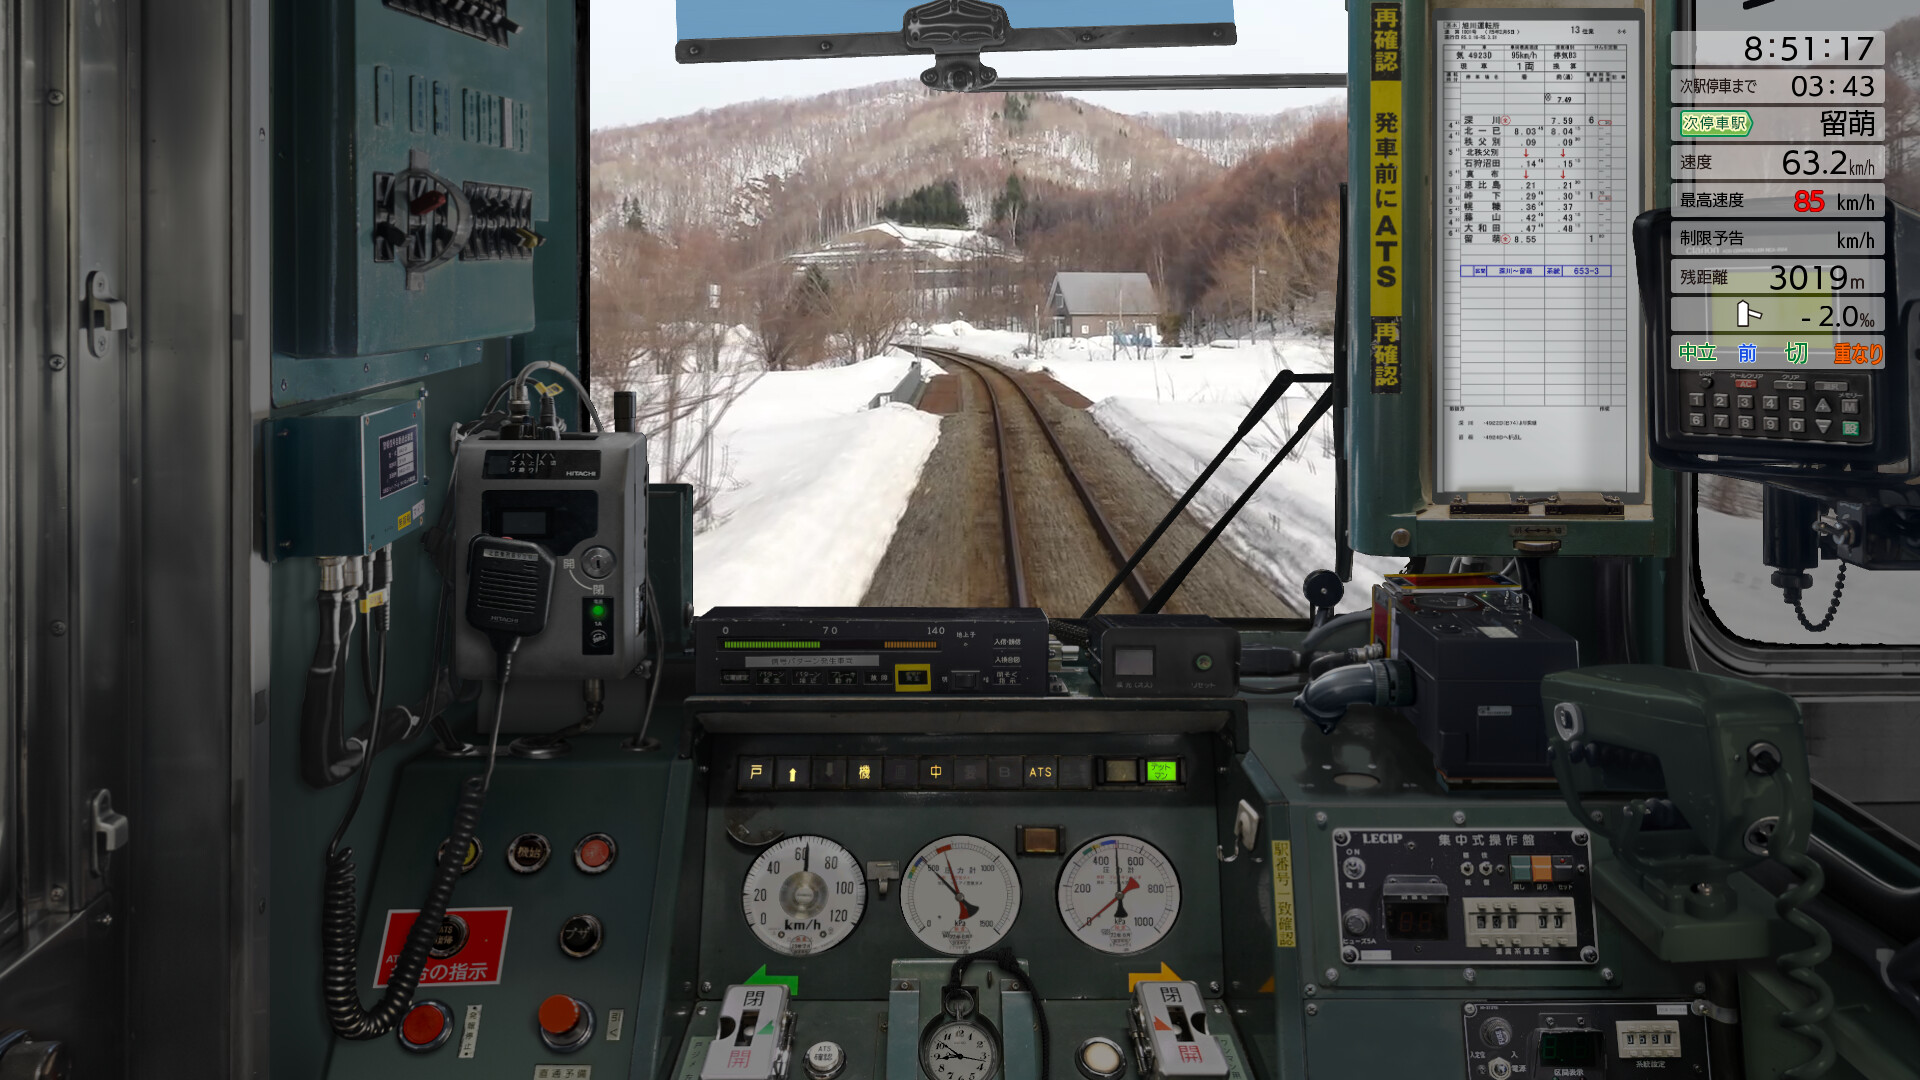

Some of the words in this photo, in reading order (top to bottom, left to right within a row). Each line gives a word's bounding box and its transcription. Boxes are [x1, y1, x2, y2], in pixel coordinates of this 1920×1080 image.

[1571, 26, 1580, 34] 13
[1374, 8, 1398, 72] 再確認
[1464, 116, 1500, 124] 深川
[1464, 138, 1500, 146] 秩父別
[1464, 159, 1500, 167] 石狩沼田
[1466, 170, 1498, 178] 真布
[1375, 112, 1398, 288] 発車前にATS
[1464, 224, 1500, 232] 大和田
[1574, 267, 1600, 275] 653-3
[1374, 322, 1398, 386] 再確認
[1694, 395, 1700, 404] 1
[1716, 396, 1724, 405] 2
[1741, 397, 1749, 406] 3
[1766, 398, 1774, 408] 4
[1792, 400, 1800, 409] 5
[1845, 402, 1855, 411] M
[1692, 416, 1700, 424] 6
[1718, 417, 1725, 426] 7
[1742, 418, 1749, 428] 8
[1766, 419, 1774, 429] 9
[1792, 421, 1800, 430] 0
[722, 626, 729, 634] 0
[823, 626, 838, 634] 70
[927, 626, 945, 635] 140
[750, 764, 762, 780] 戸
[859, 765, 870, 780] 機
[930, 764, 942, 779] 中
[1030, 767, 1051, 778] ATS
[1362, 833, 1403, 844] LECIP
[1438, 834, 1535, 846] 集中式操作盤
[825, 856, 838, 869] 80
[1093, 856, 1109, 865] 400
[1128, 857, 1144, 866] 600
[767, 861, 780, 874] 40
[836, 881, 854, 894] 100
[1074, 884, 1091, 893] 200
[1148, 884, 1164, 893] 800
[754, 889, 766, 901] 20
[1274, 842, 1294, 946] 駅番号一致確認
[760, 913, 766, 924] 0
[830, 909, 848, 922] 120
[785, 919, 821, 930] km/h
[1134, 917, 1153, 926] 1000
[744, 990, 765, 1006] 閉
[1160, 987, 1182, 1003] 閉
[814, 1053, 833, 1061] 確認
[1178, 1045, 1203, 1063] 開
[728, 1050, 751, 1068] 開
[938, 1064, 944, 1072] 8
[1554, 1068, 1584, 1077] 区間表示
